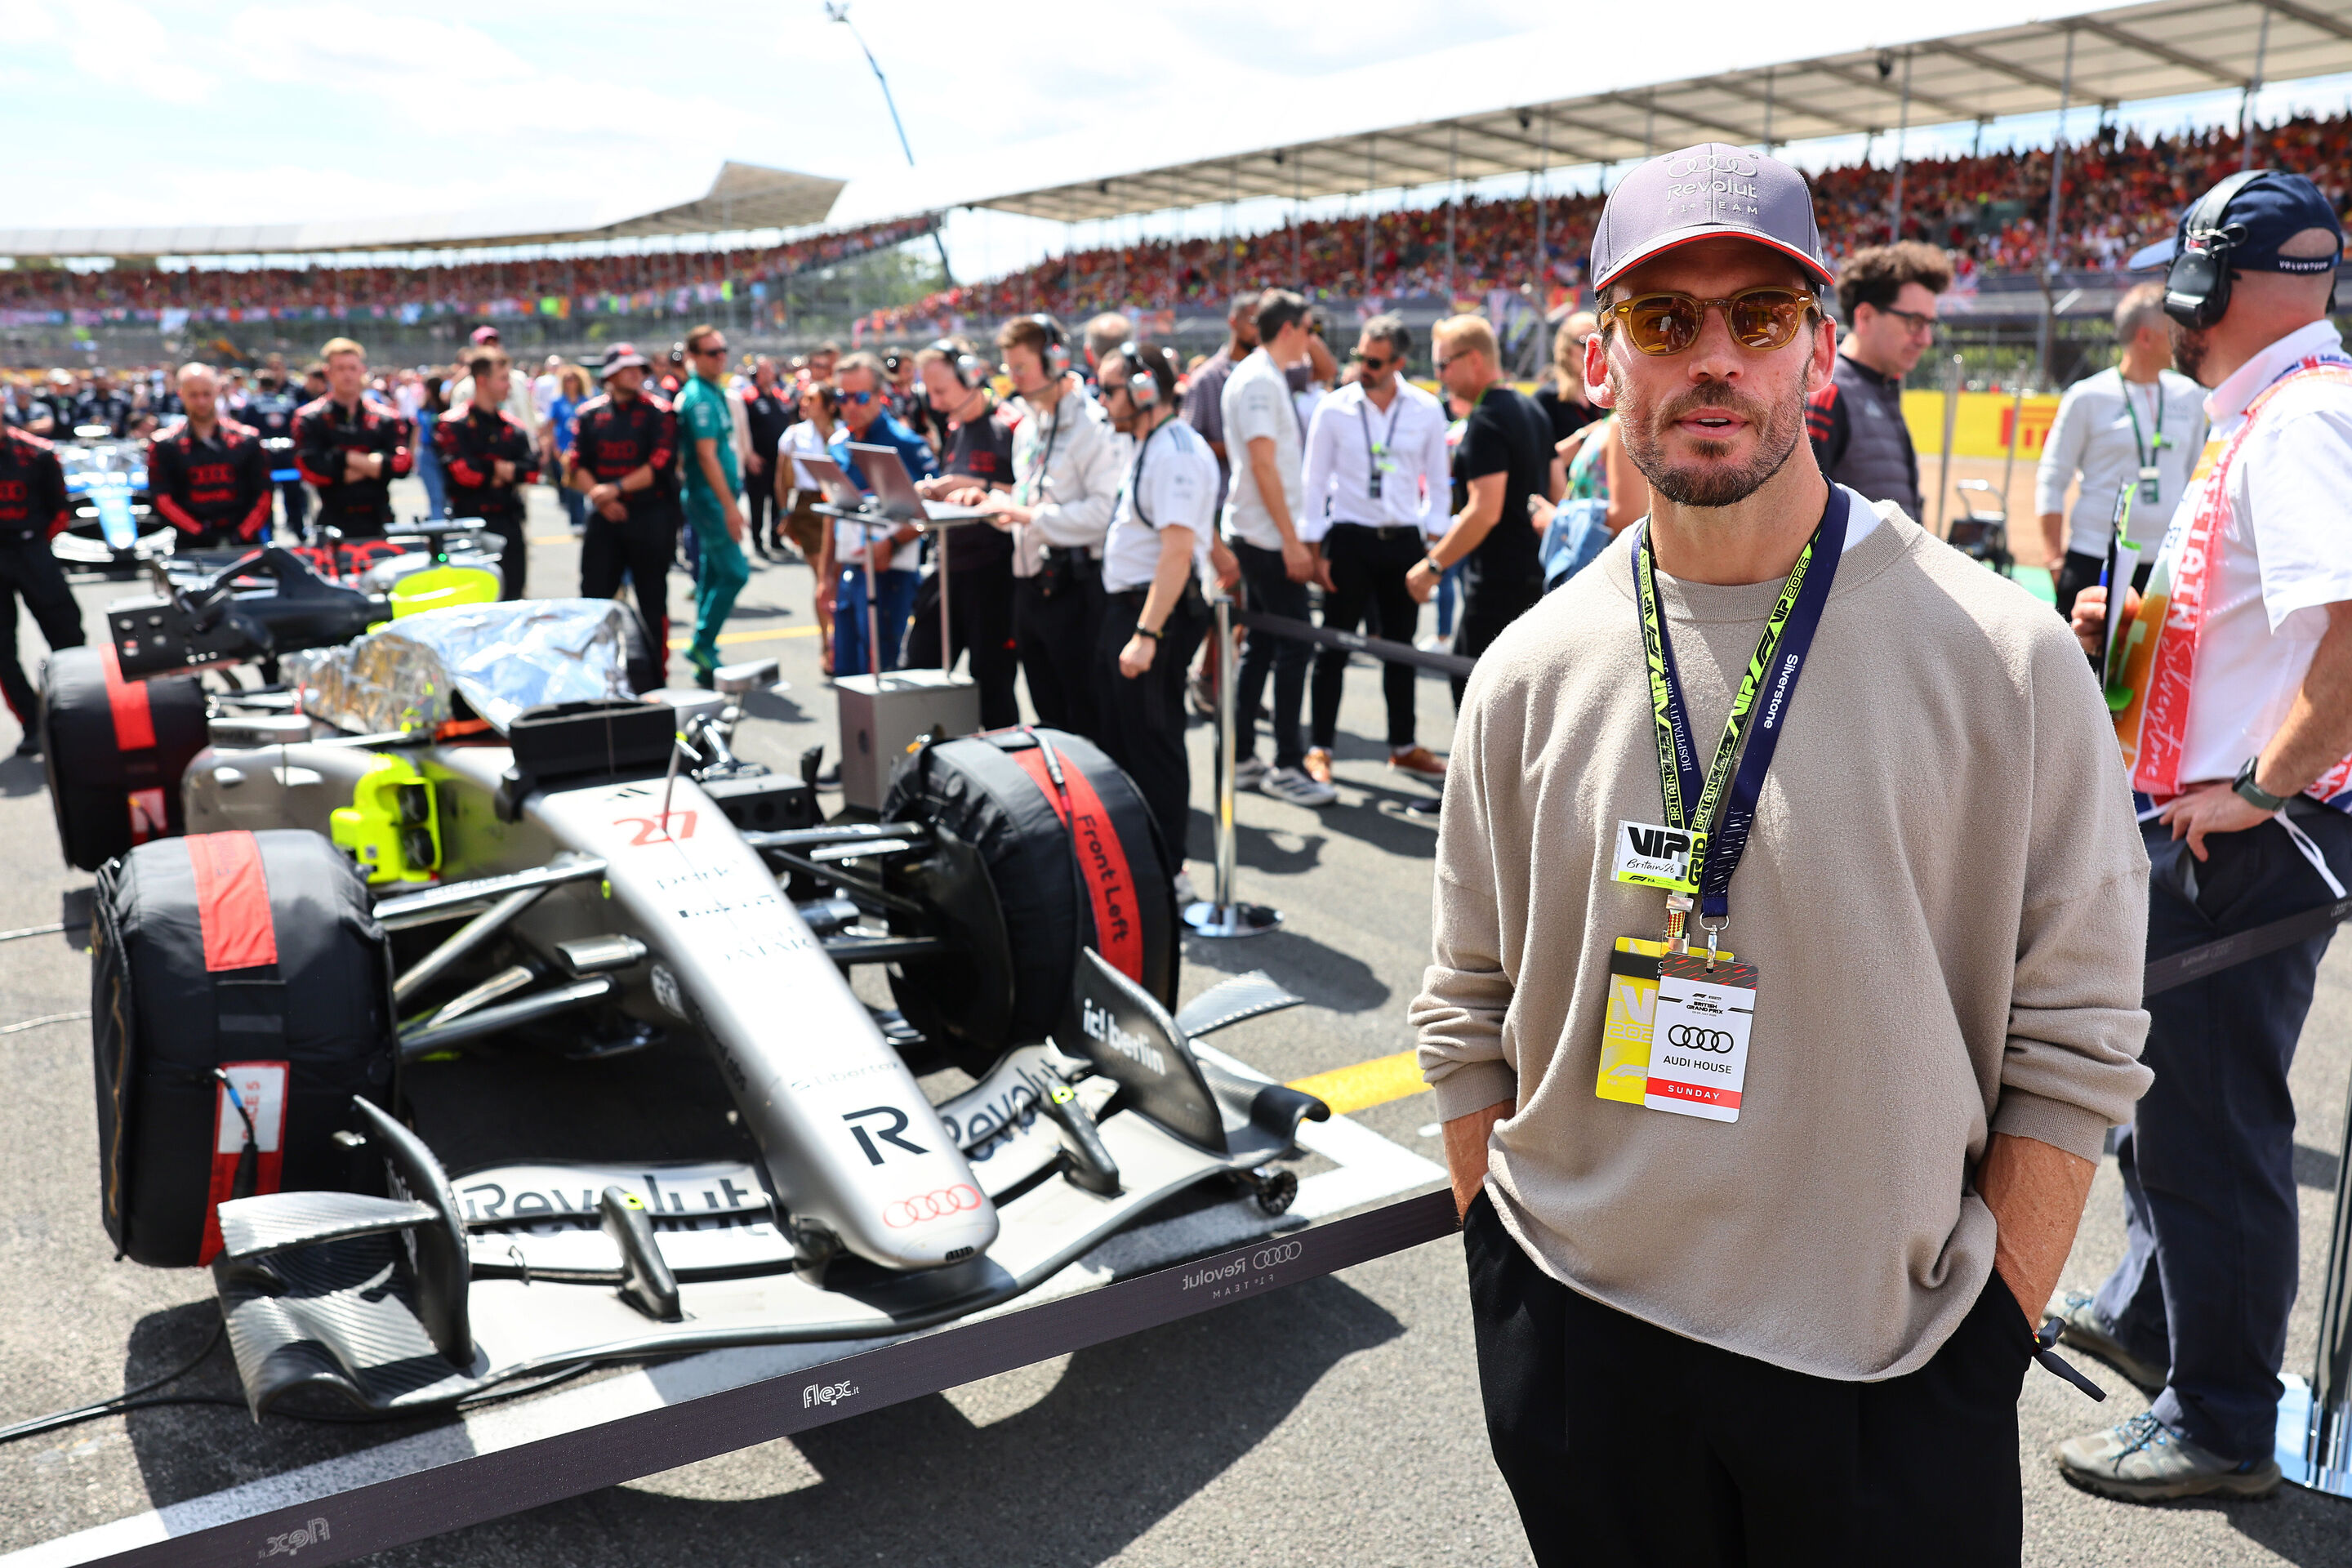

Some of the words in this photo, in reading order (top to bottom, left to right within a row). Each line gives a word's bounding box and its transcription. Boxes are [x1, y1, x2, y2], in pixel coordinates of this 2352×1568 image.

[1667, 178, 1758, 202] Revolut
[1705, 201, 1758, 215] TEAM
[1783, 555, 1811, 599] 2026
[1770, 598, 1791, 624] VIP
[1732, 675, 1757, 716] VIP
[1764, 653, 1799, 729] Silverstone
[1665, 773, 1681, 821] BRITAIN
[1694, 781, 1718, 830] BRITAIN
[612, 810, 698, 847] 27
[1627, 826, 1690, 860] VIP
[1077, 814, 1116, 882] Front
[1104, 886, 1129, 943] Left
[1107, 1013, 1166, 1076] berlin
[1607, 1022, 1654, 1043] 202
[1663, 1055, 1690, 1067] AUDI
[1694, 1060, 1733, 1074] HOUSE
[1667, 1085, 1721, 1100] SUNDAY
[841, 1106, 932, 1166] R
[462, 1174, 768, 1238] Revlut
